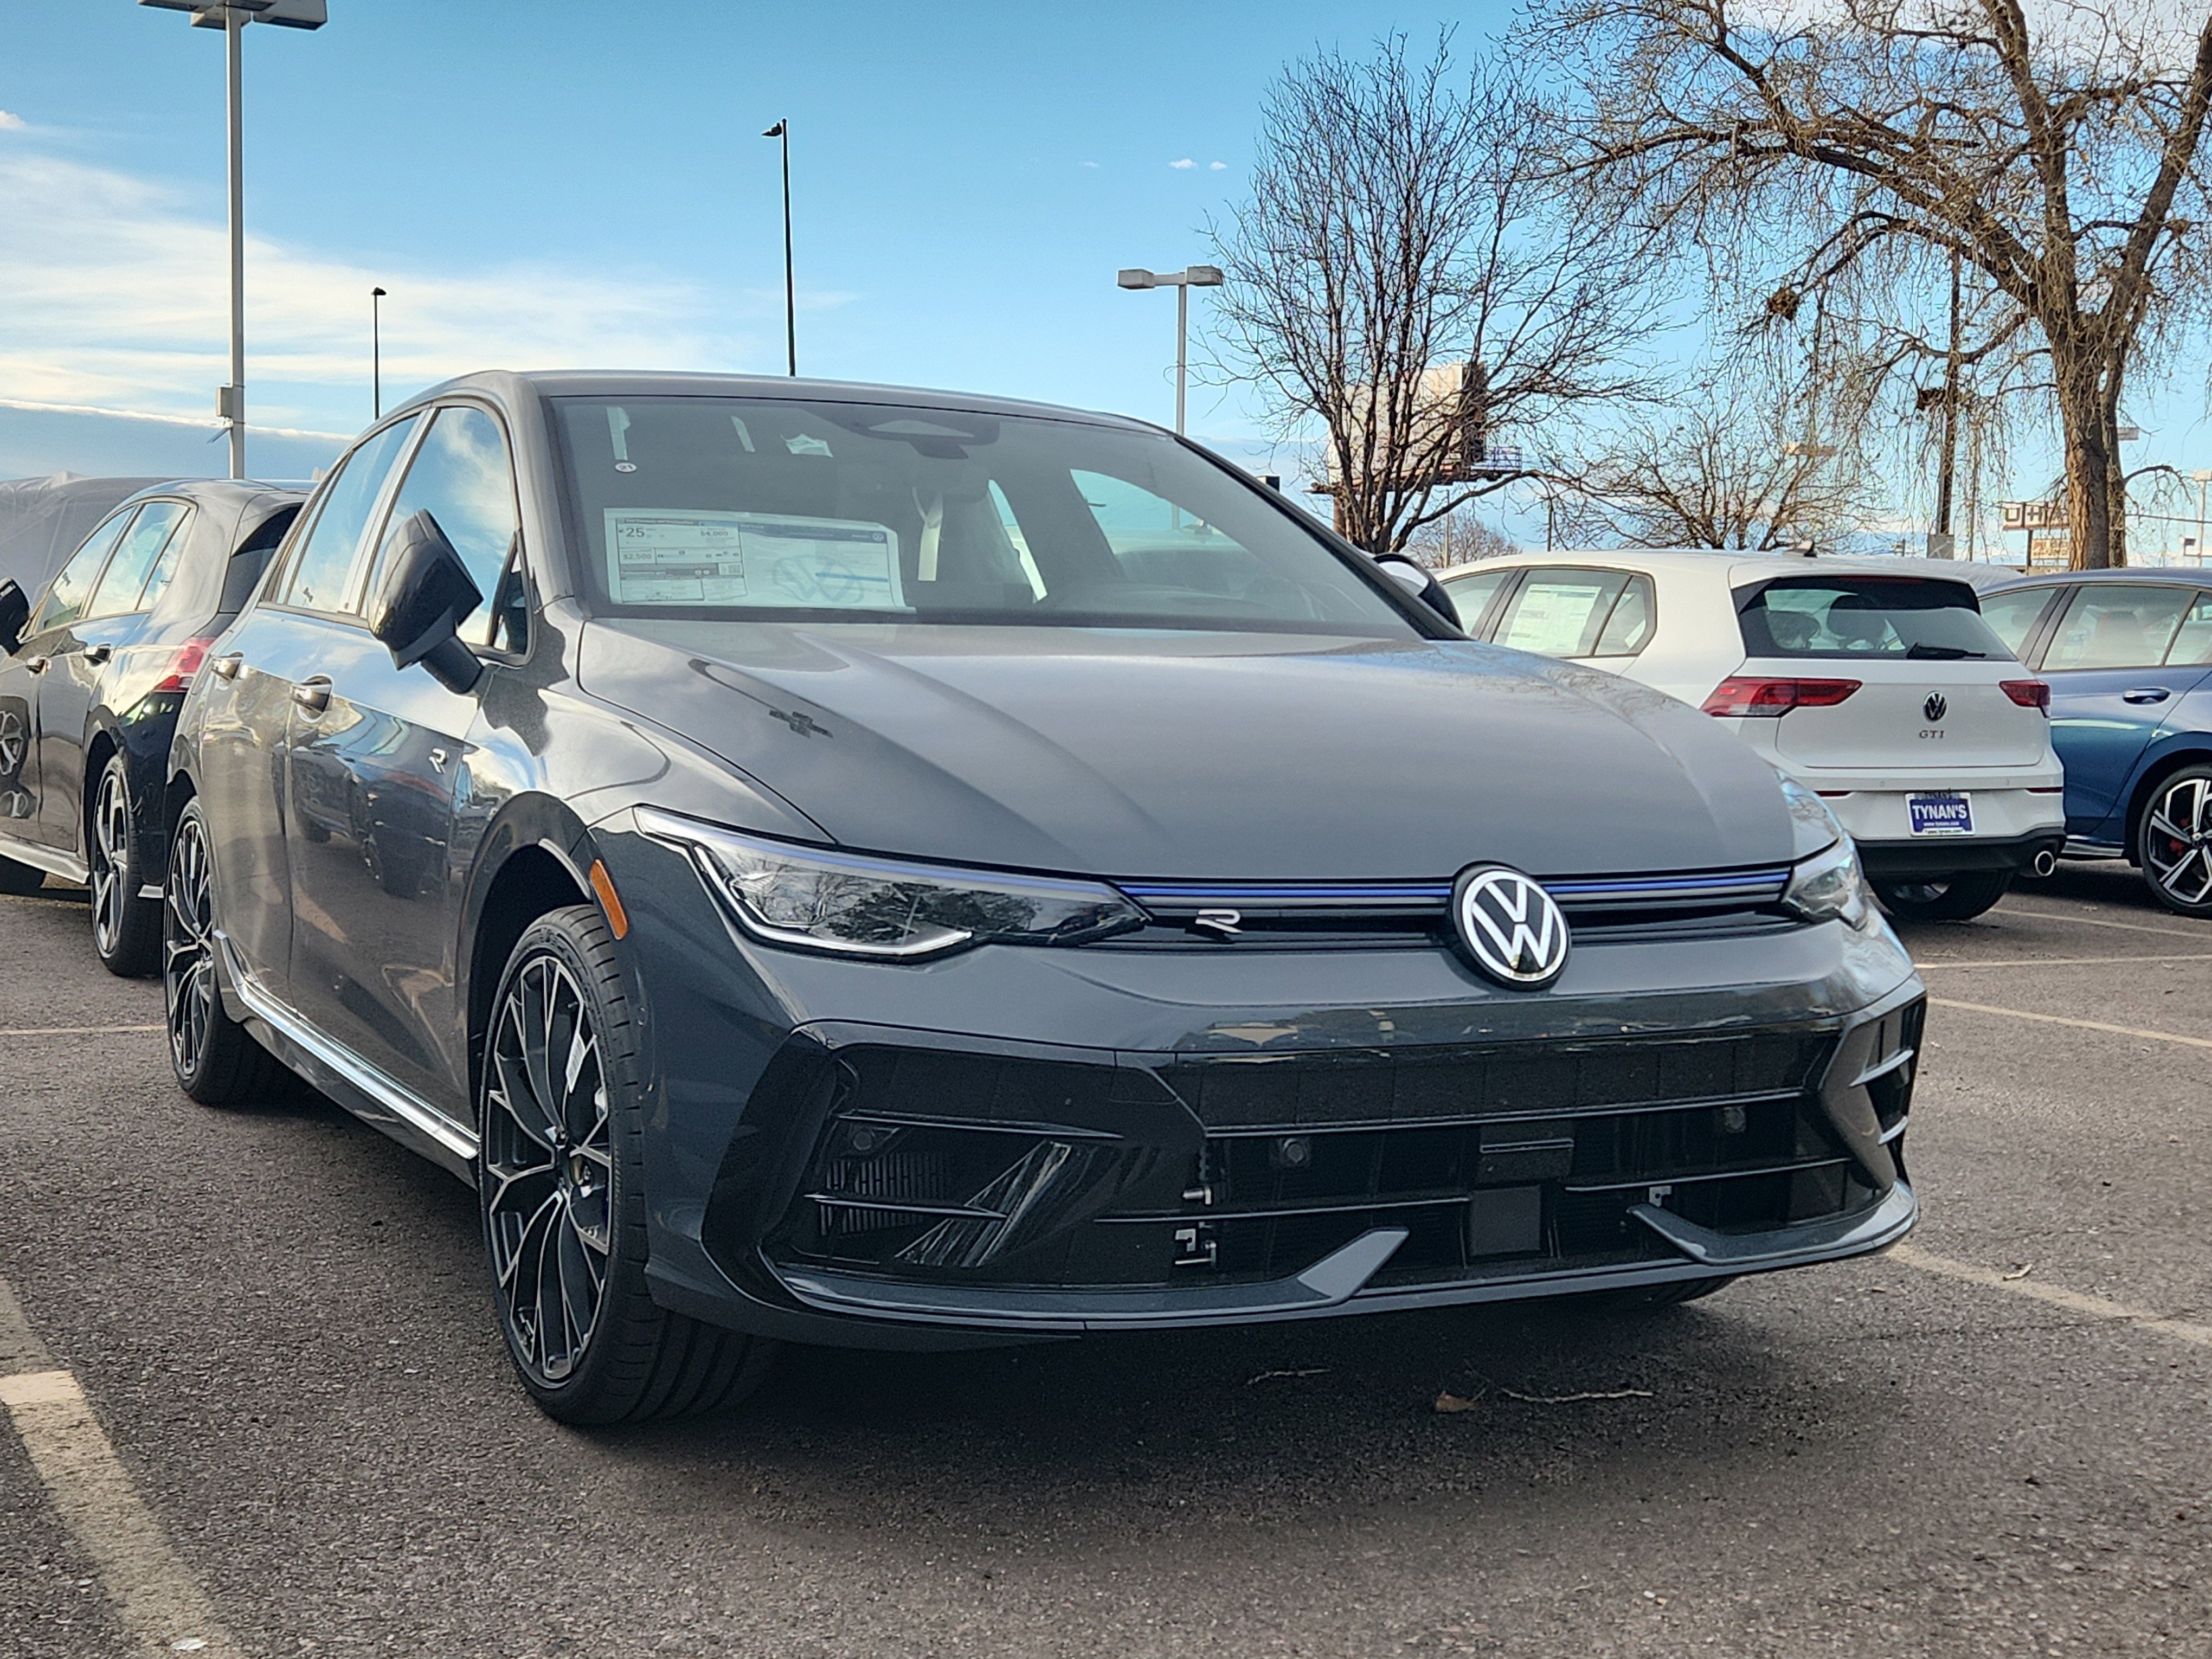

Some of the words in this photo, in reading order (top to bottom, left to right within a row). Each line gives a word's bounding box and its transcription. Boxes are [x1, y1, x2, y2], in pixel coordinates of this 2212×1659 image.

[626, 528, 645, 537] 25
[1919, 730, 1945, 738] GTI
[428, 748, 447, 774] R
[1912, 805, 1967, 820] TYNAN'S
[1195, 909, 1243, 935] R
[1469, 878, 1555, 972] VW
